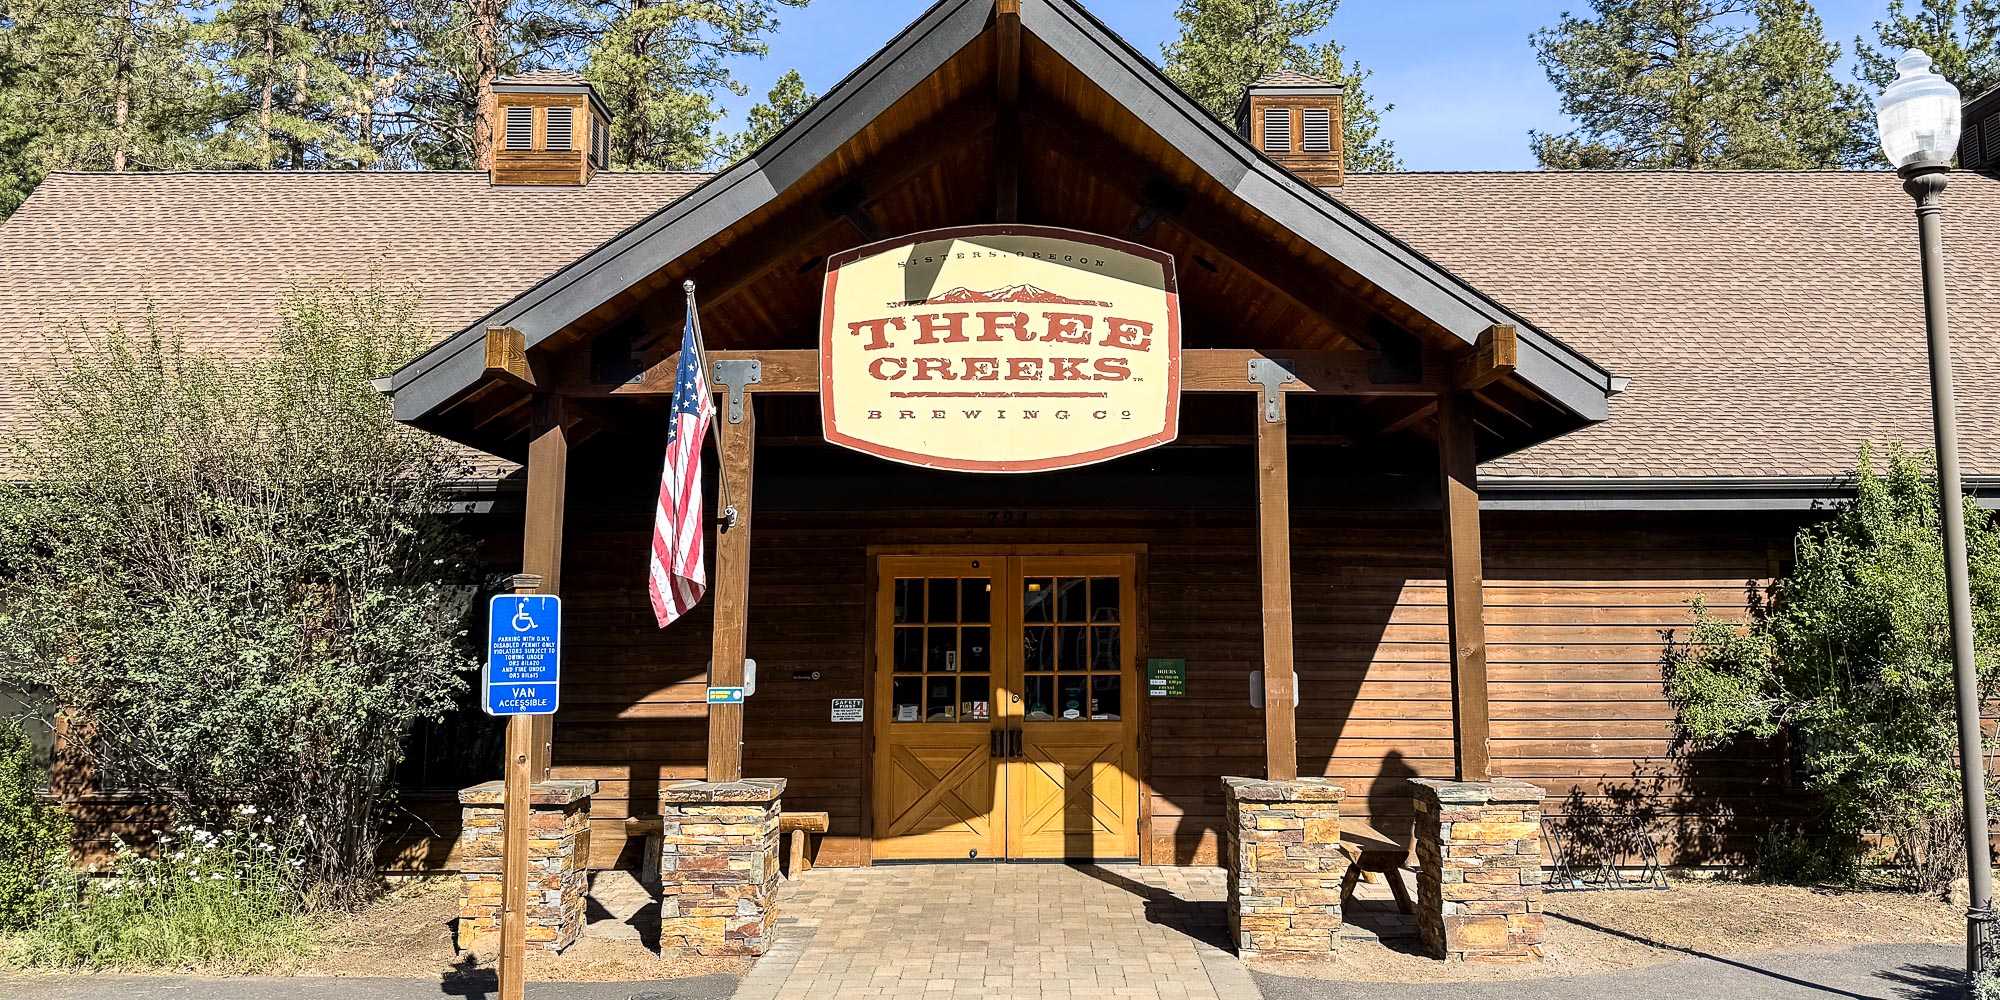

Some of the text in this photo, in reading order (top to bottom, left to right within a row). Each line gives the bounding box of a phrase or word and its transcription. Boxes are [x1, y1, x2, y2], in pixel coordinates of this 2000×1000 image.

[1016, 250, 1105, 268] OREGON
[848, 311, 1154, 352] THREE
[868, 357, 1131, 381] CREEKS
[867, 409, 1070, 420] BREWING
[511, 687, 535, 698] VAN
[498, 698, 548, 707] ACCESSIBLE
